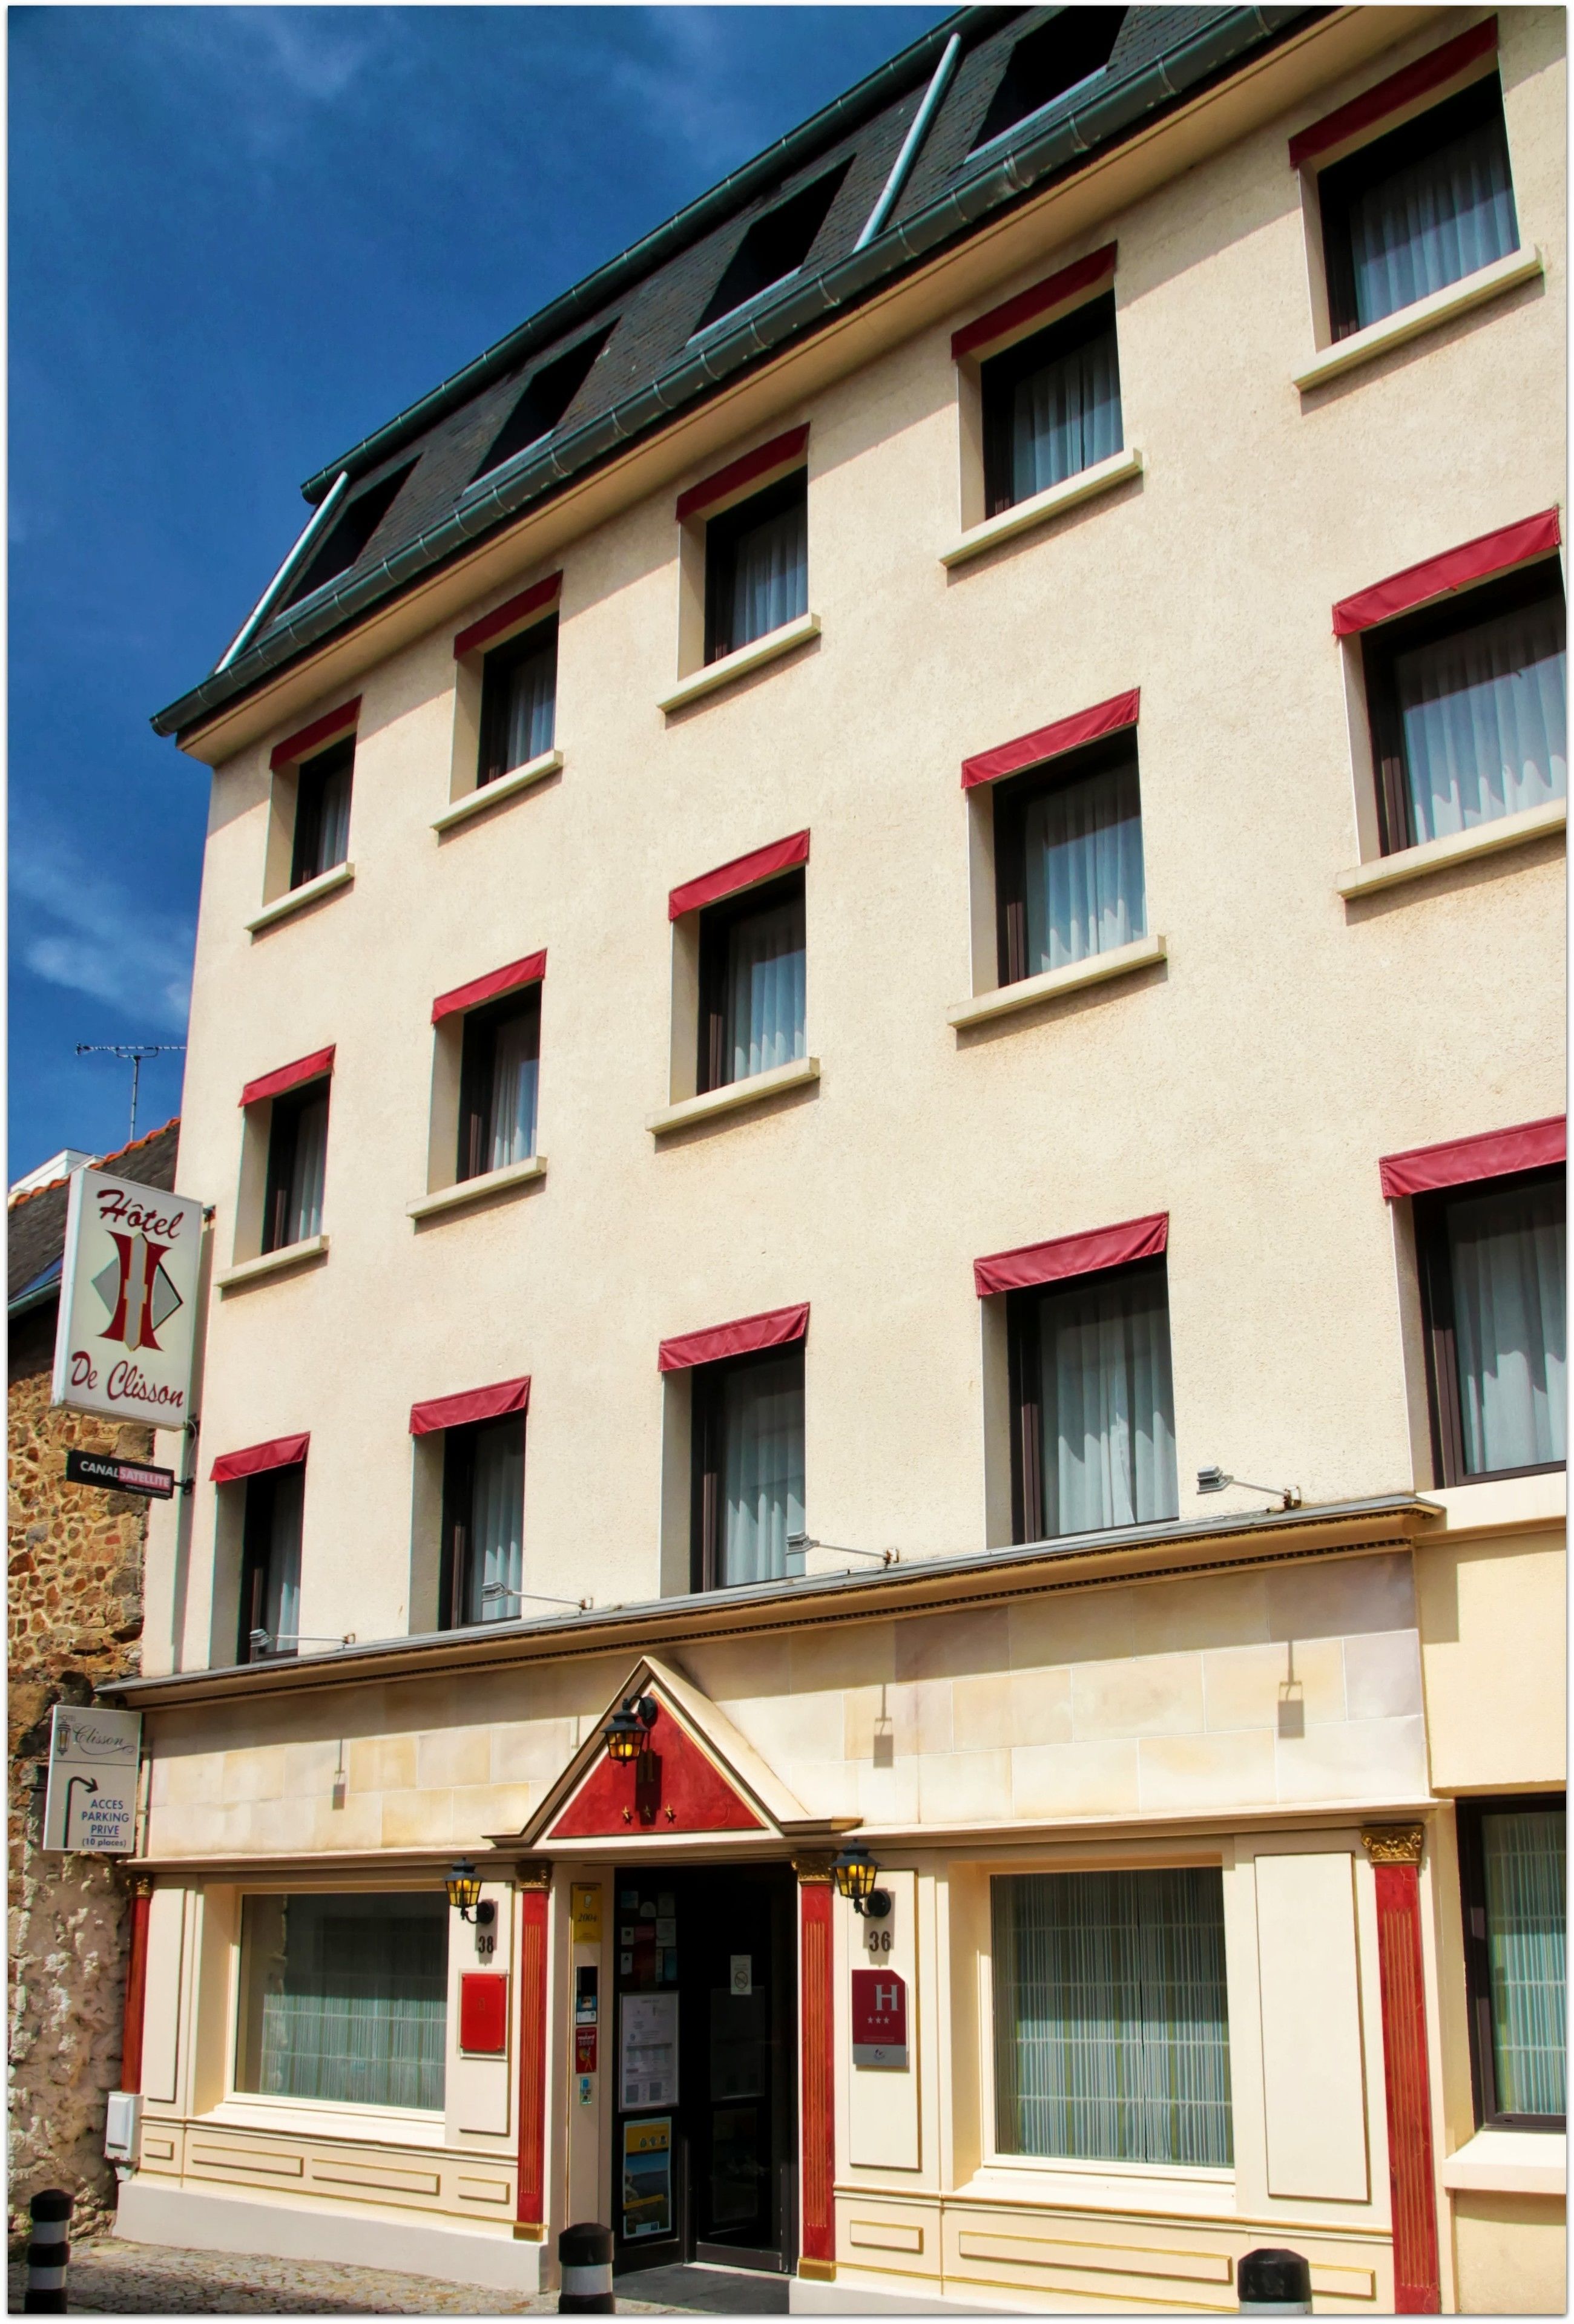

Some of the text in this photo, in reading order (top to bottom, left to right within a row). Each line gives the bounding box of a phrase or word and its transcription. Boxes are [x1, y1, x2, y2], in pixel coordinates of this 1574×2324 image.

[97, 1189, 184, 1239] Hôtel
[71, 1351, 184, 1408] De Clisson
[73, 1724, 134, 1755] Clisson
[90, 1799, 123, 1810] ACCES
[82, 1811, 130, 1823] PARKING
[91, 1824, 119, 1835] PRIVE
[82, 1837, 127, 1848] (10 places)
[478, 1935, 494, 1954] 38
[869, 1931, 891, 1952] 36
[875, 1984, 898, 2011] H
